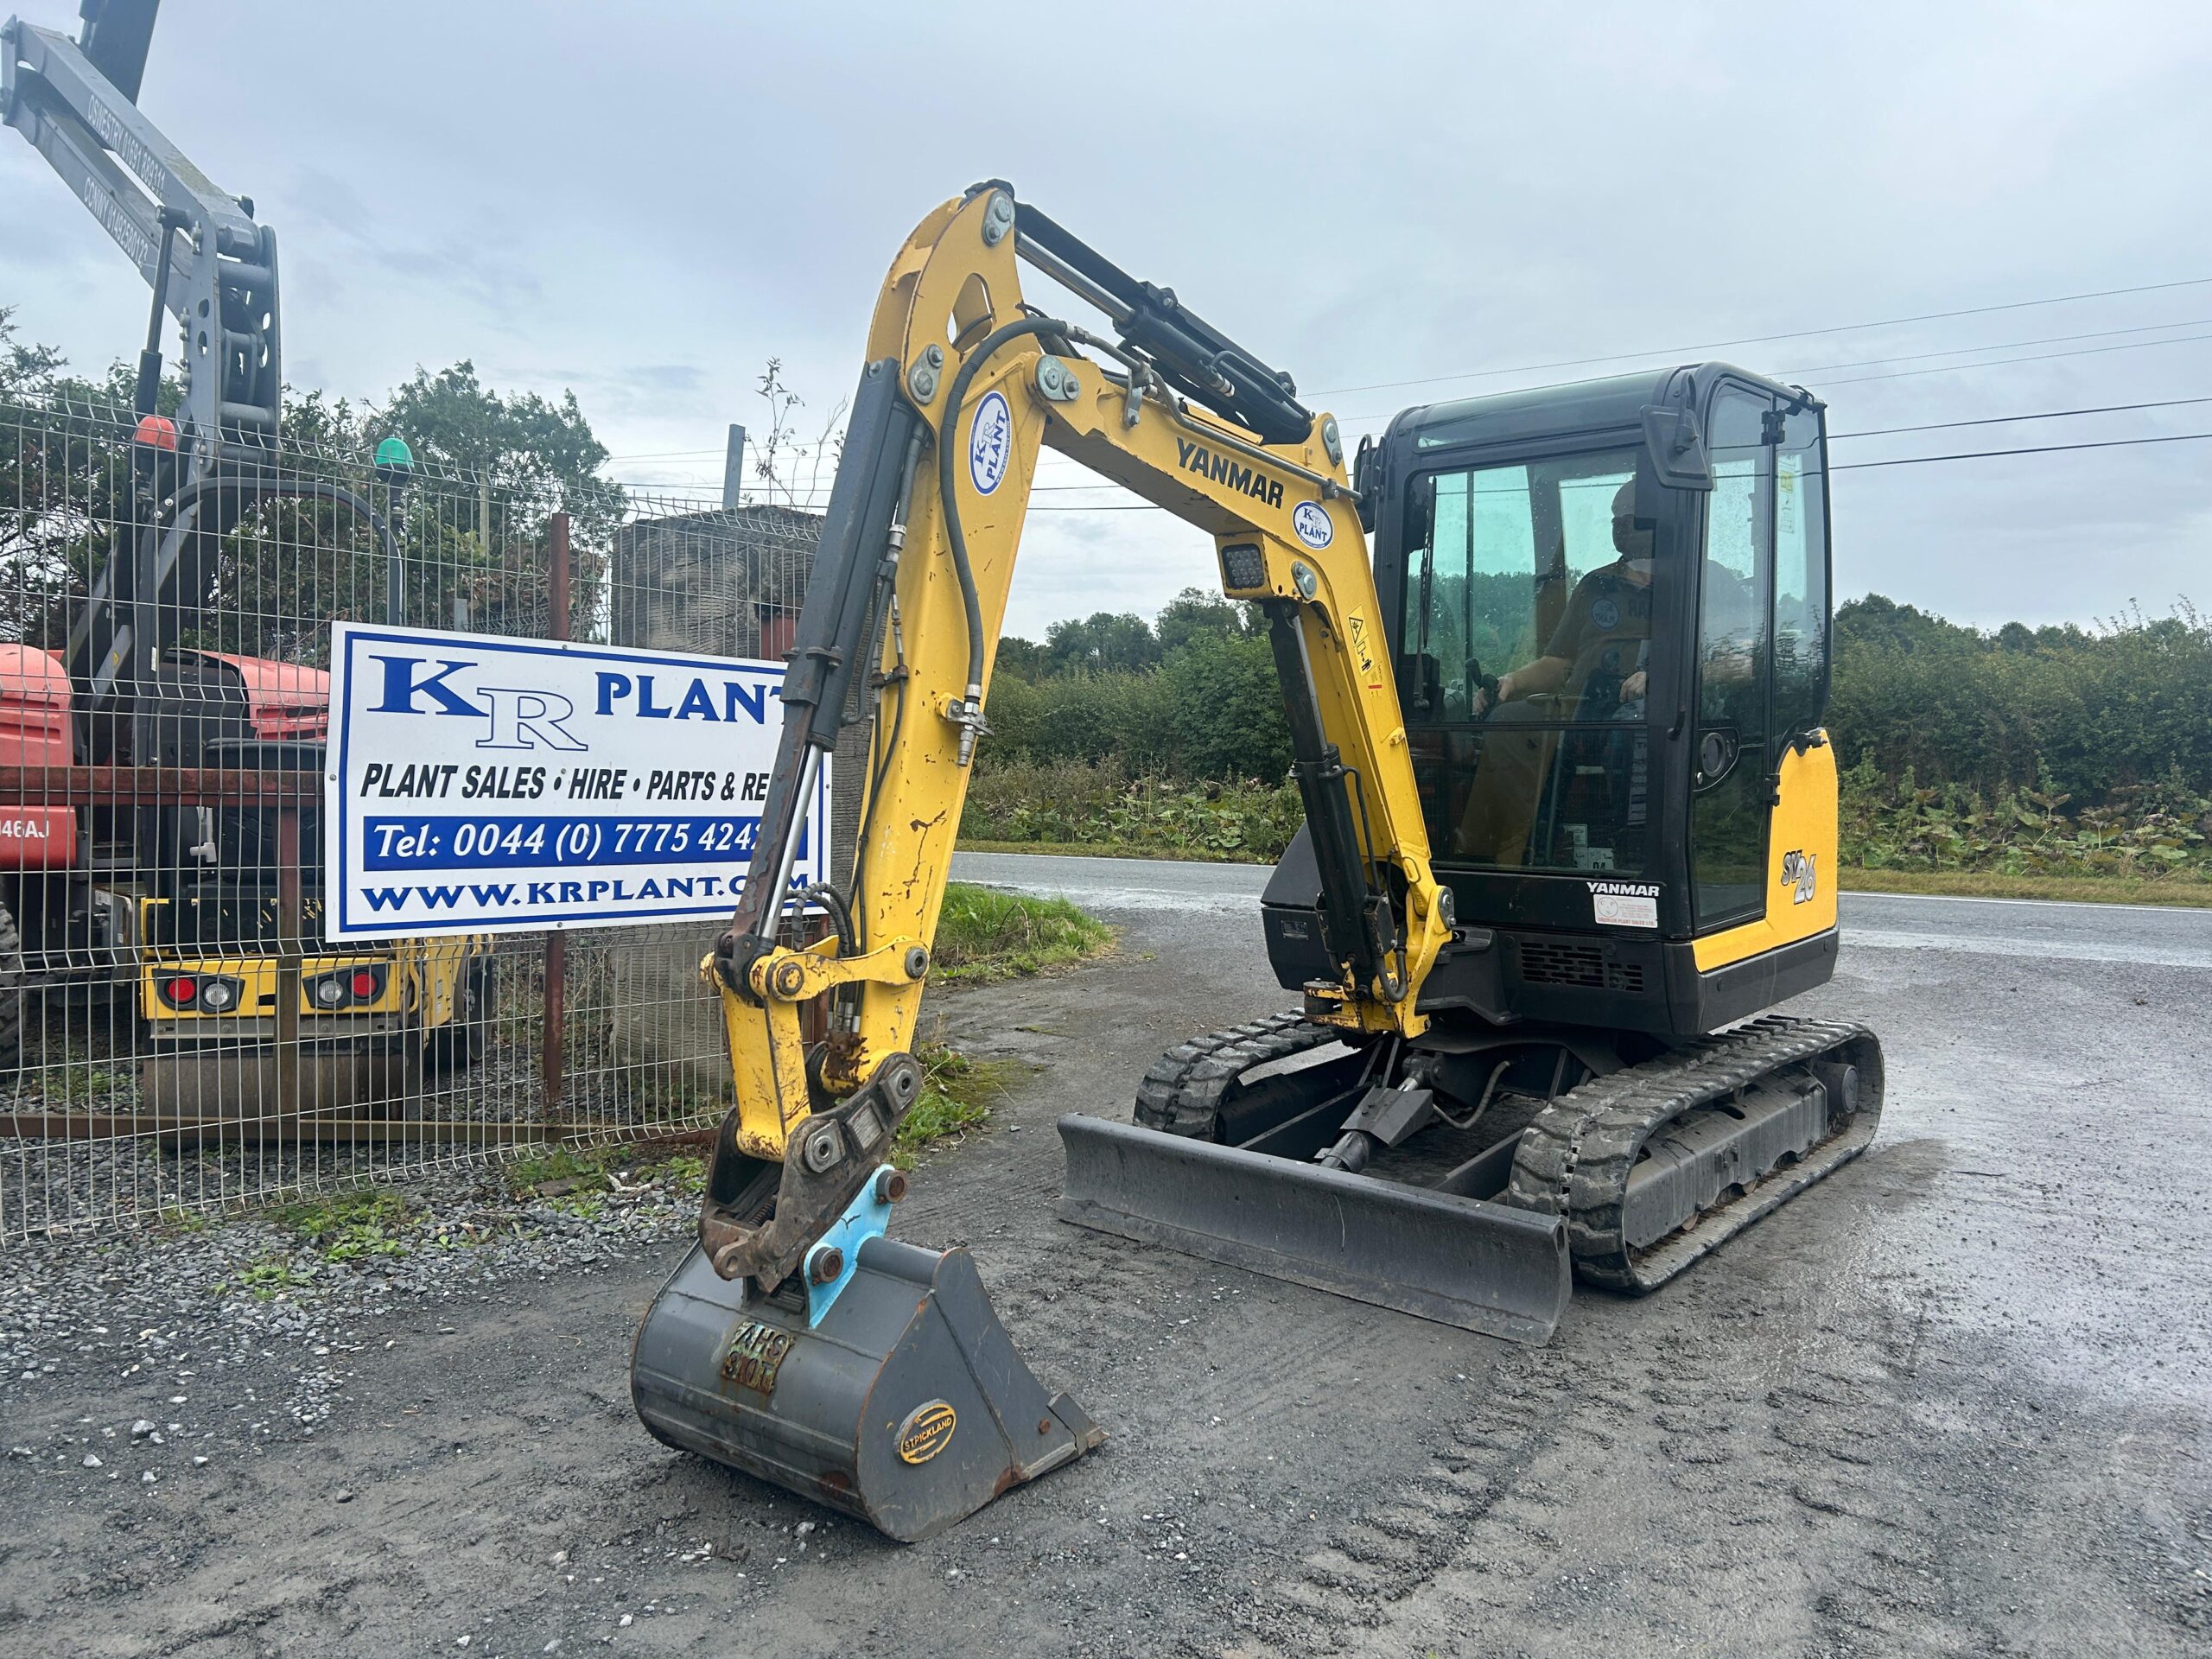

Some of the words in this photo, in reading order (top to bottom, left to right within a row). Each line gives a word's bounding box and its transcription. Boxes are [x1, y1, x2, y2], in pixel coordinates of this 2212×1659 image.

[88, 94, 124, 152] OSWESTRY
[122, 130, 143, 175] 01691
[84, 176, 110, 224] CONWY
[986, 410, 1006, 480] PLANT
[1176, 436, 1284, 509] YANMAR
[1299, 522, 1328, 542] PLANT
[594, 671, 784, 726] PLAN
[360, 763, 459, 798] PLANT
[461, 766, 546, 799] SALES
[568, 768, 628, 800] HIRE
[645, 770, 717, 801] PARTS
[720, 772, 735, 801] &
[741, 772, 770, 802] RE
[0, 820, 49, 838] 46AJ
[373, 823, 440, 858] Tel:
[453, 823, 545, 856] 0044
[556, 823, 601, 861] (0)
[614, 823, 691, 853] 7775
[698, 822, 762, 851] 424
[1586, 881, 1660, 897] YANMAR
[905, 1416, 952, 1451] STRICKLAND
